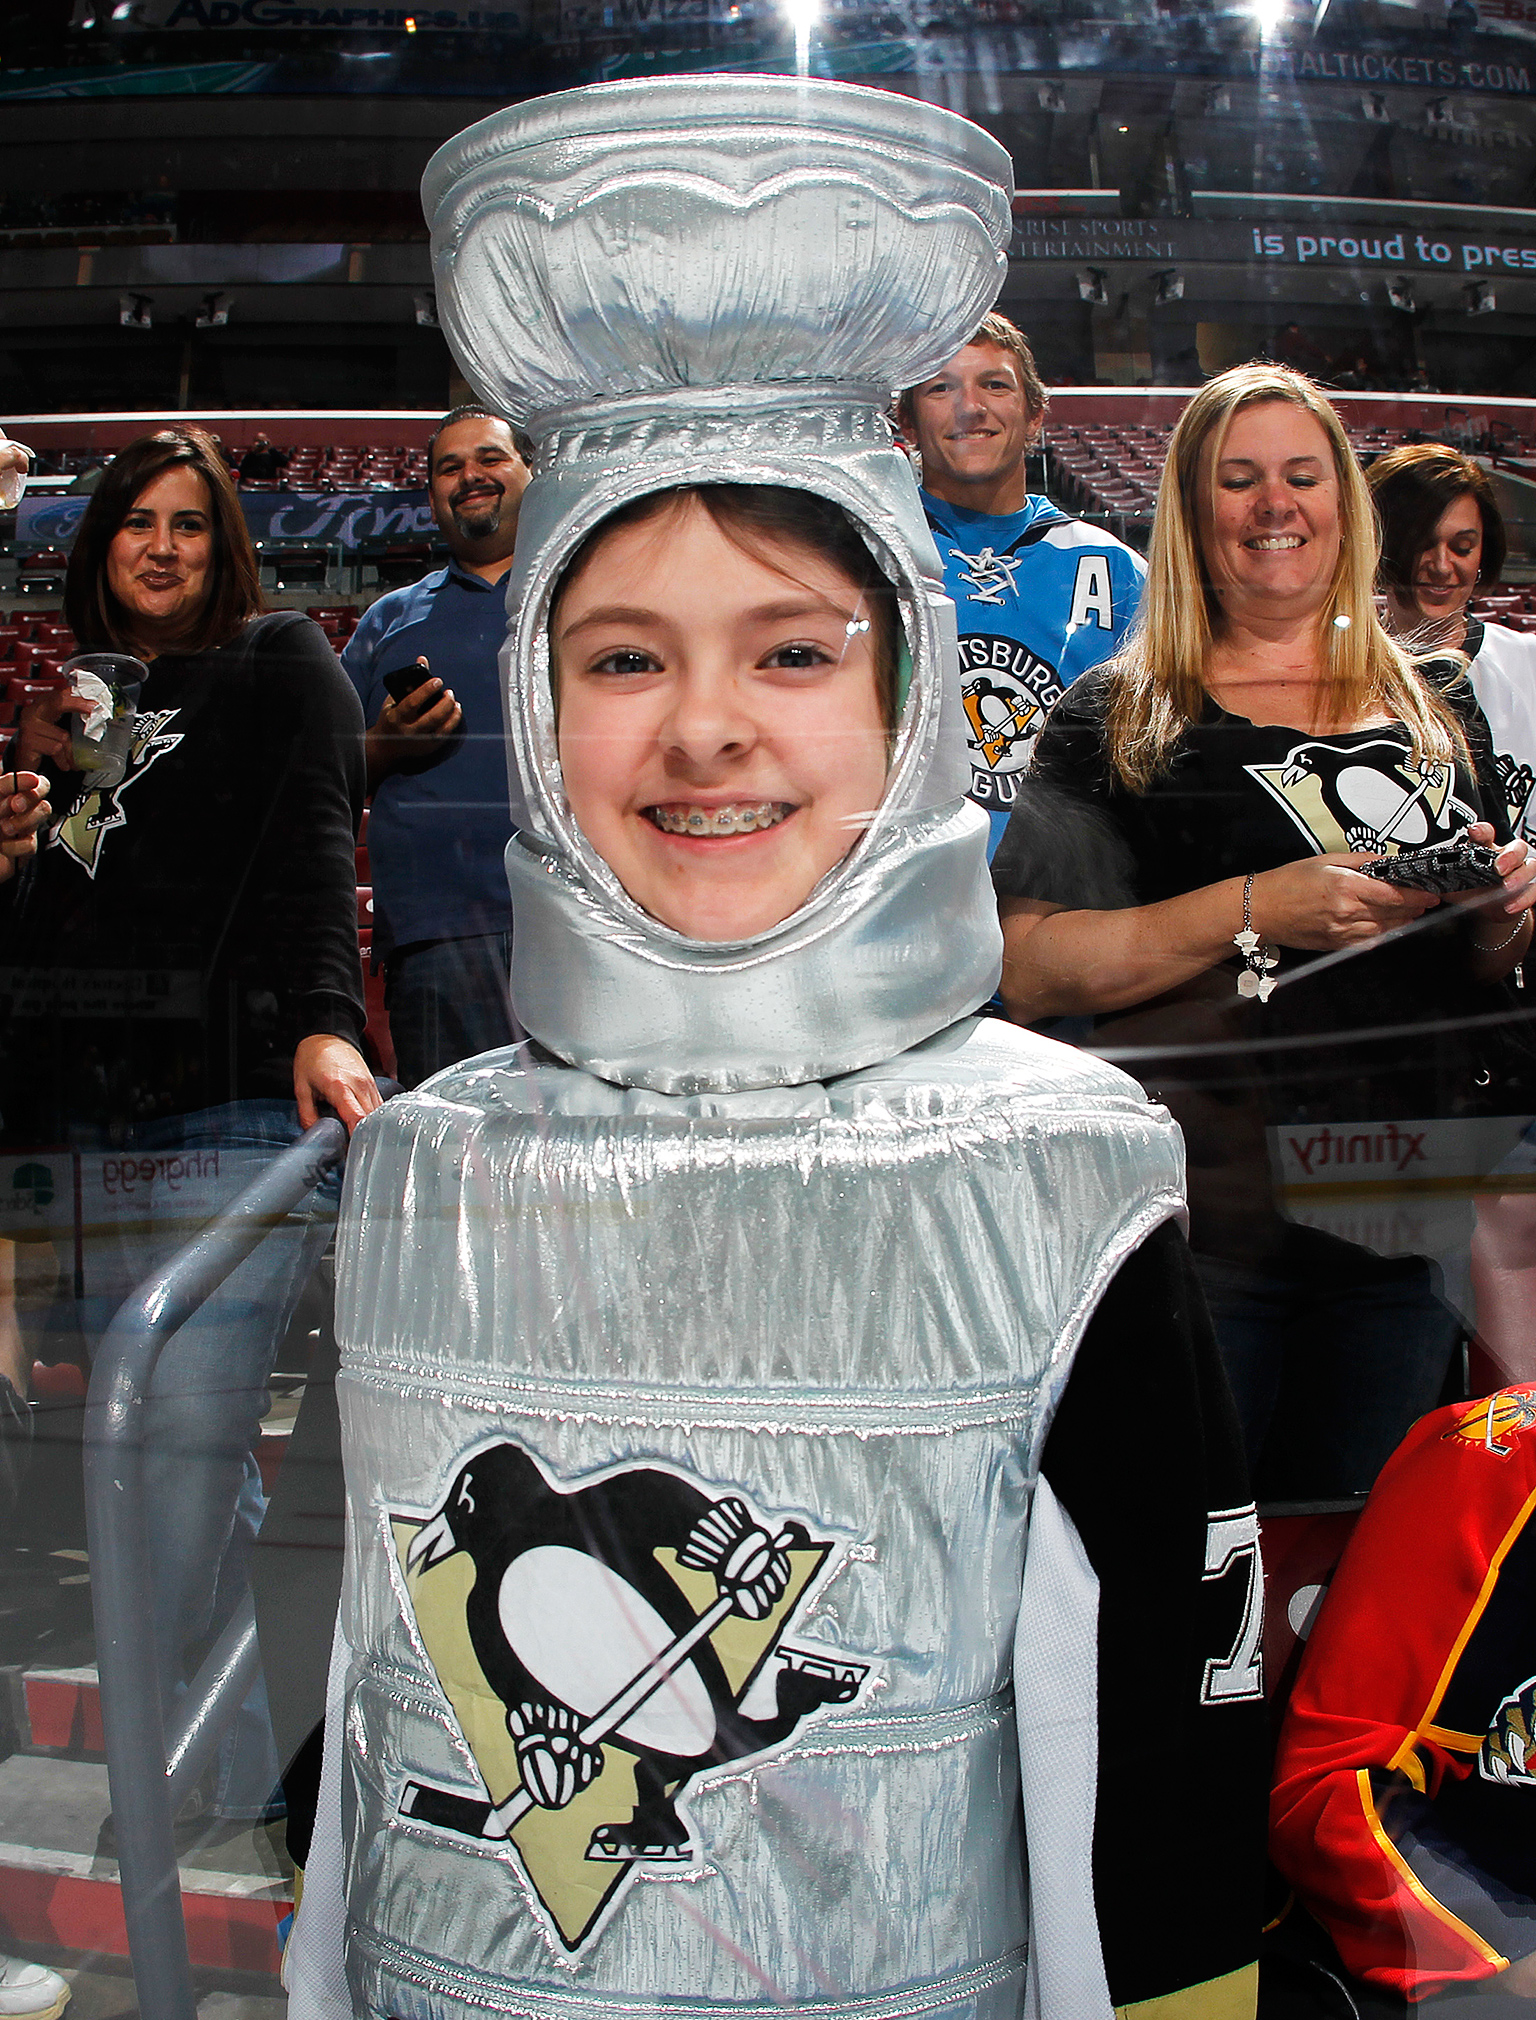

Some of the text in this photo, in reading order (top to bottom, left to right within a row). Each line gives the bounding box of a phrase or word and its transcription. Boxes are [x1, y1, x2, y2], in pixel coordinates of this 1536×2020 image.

[1079, 219, 1158, 236] SPORTS
[1252, 227, 1536, 271] is proud to pres
[1070, 555, 1113, 630] A
[957, 637, 1062, 713] TSBURG
[1201, 1501, 1265, 1705] 7
